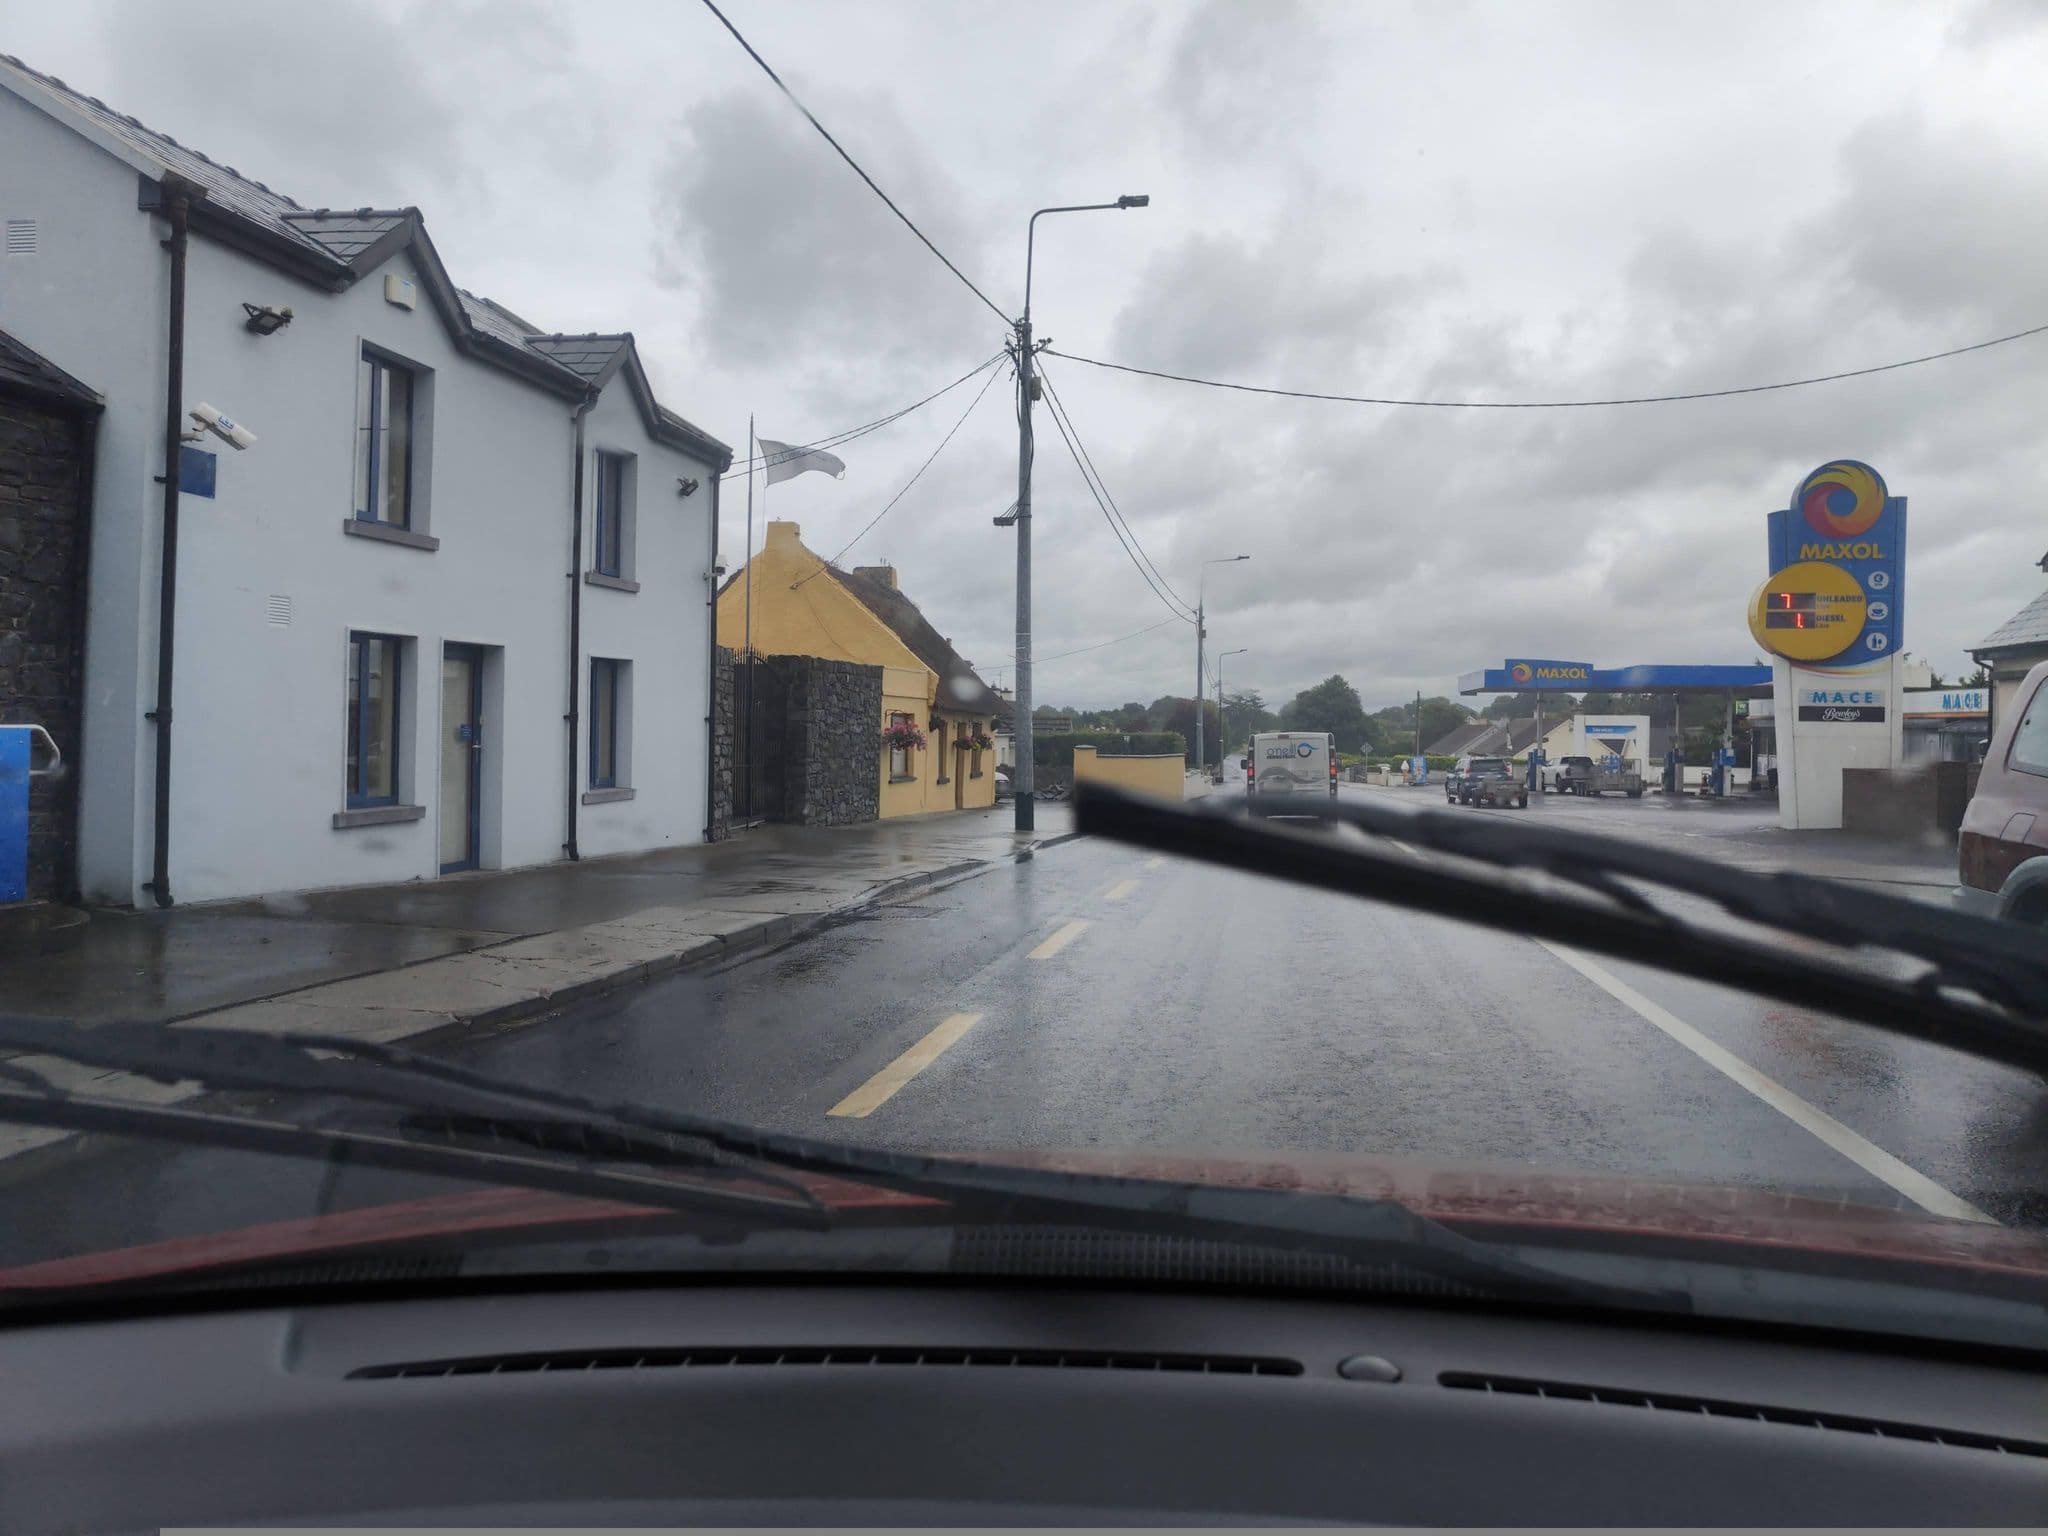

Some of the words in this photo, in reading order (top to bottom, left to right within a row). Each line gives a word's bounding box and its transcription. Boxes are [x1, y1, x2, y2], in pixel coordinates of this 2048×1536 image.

[1800, 543, 1886, 560] MAXOL
[1816, 614, 1845, 622] DIESEL
[1536, 667, 1587, 679] MAXOL
[1812, 691, 1873, 704] MACE
[1942, 692, 1982, 709] MACE
